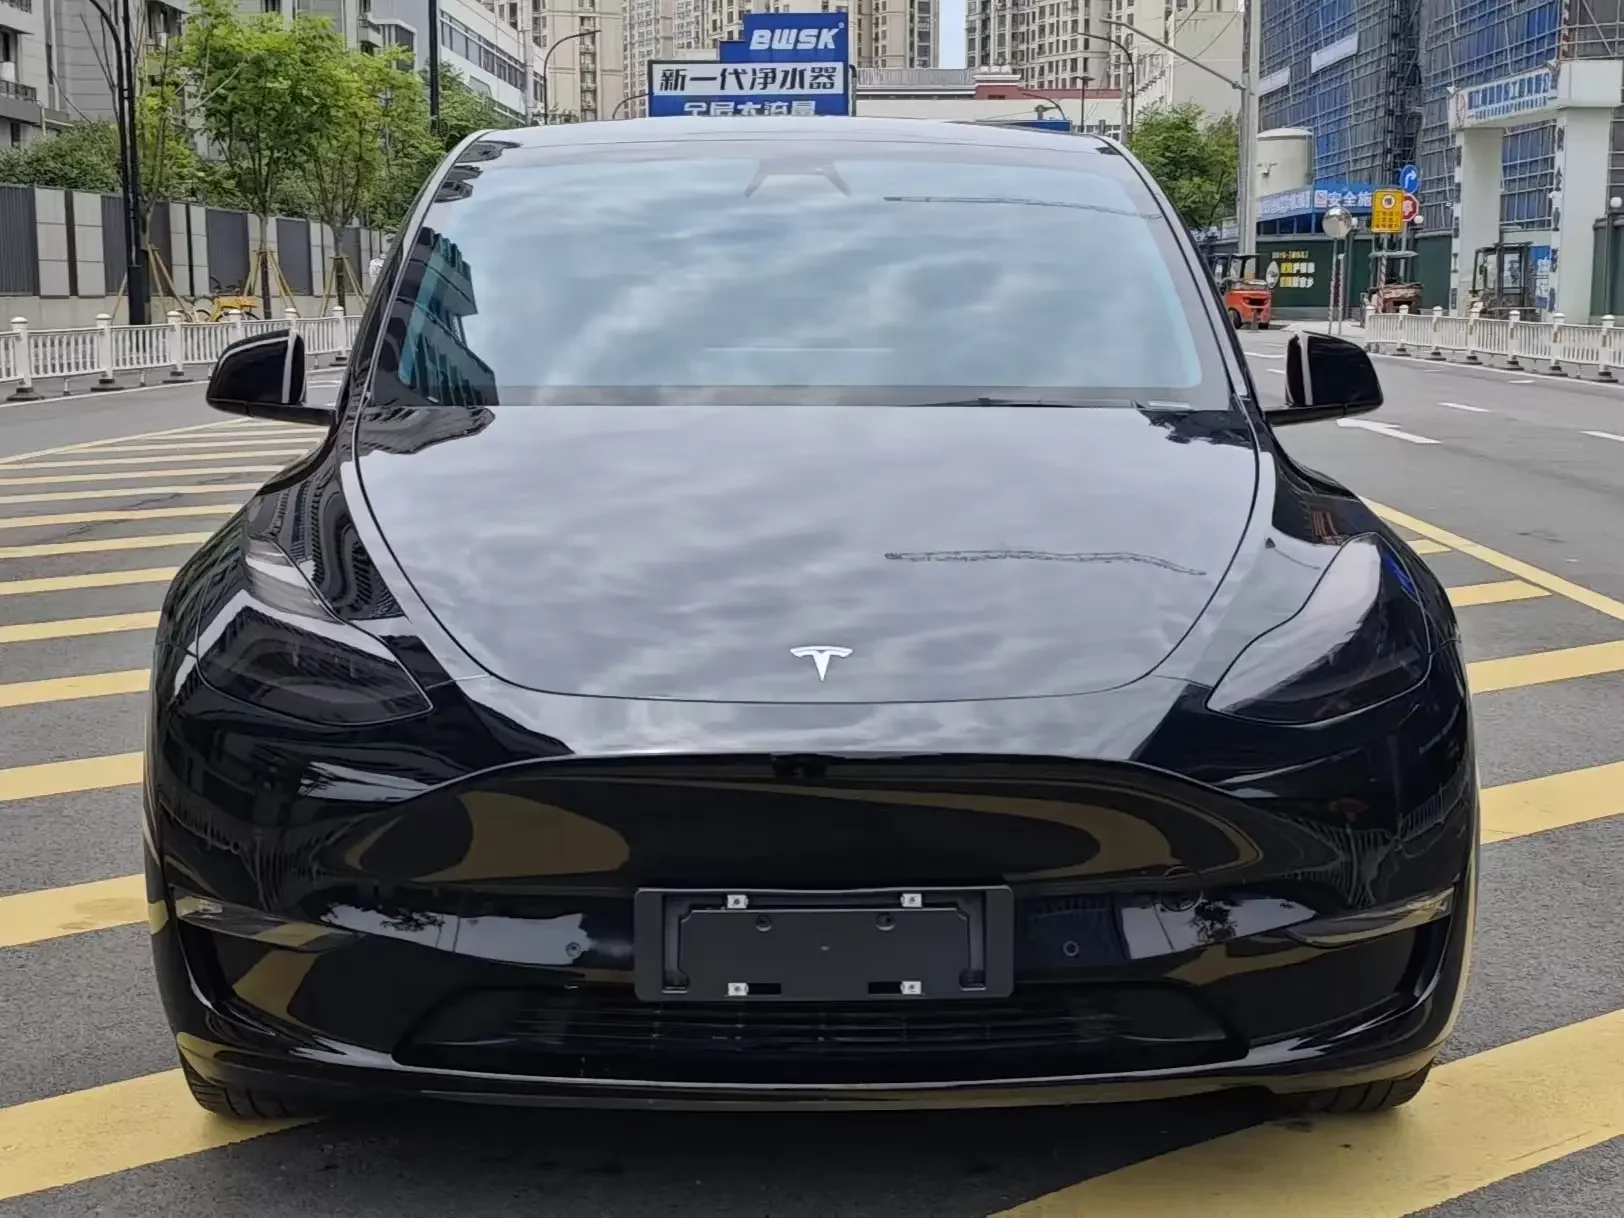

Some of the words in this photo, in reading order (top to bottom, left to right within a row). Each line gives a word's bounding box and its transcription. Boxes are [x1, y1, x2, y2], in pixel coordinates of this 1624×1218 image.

[659, 66, 837, 91] 新一代净水器
